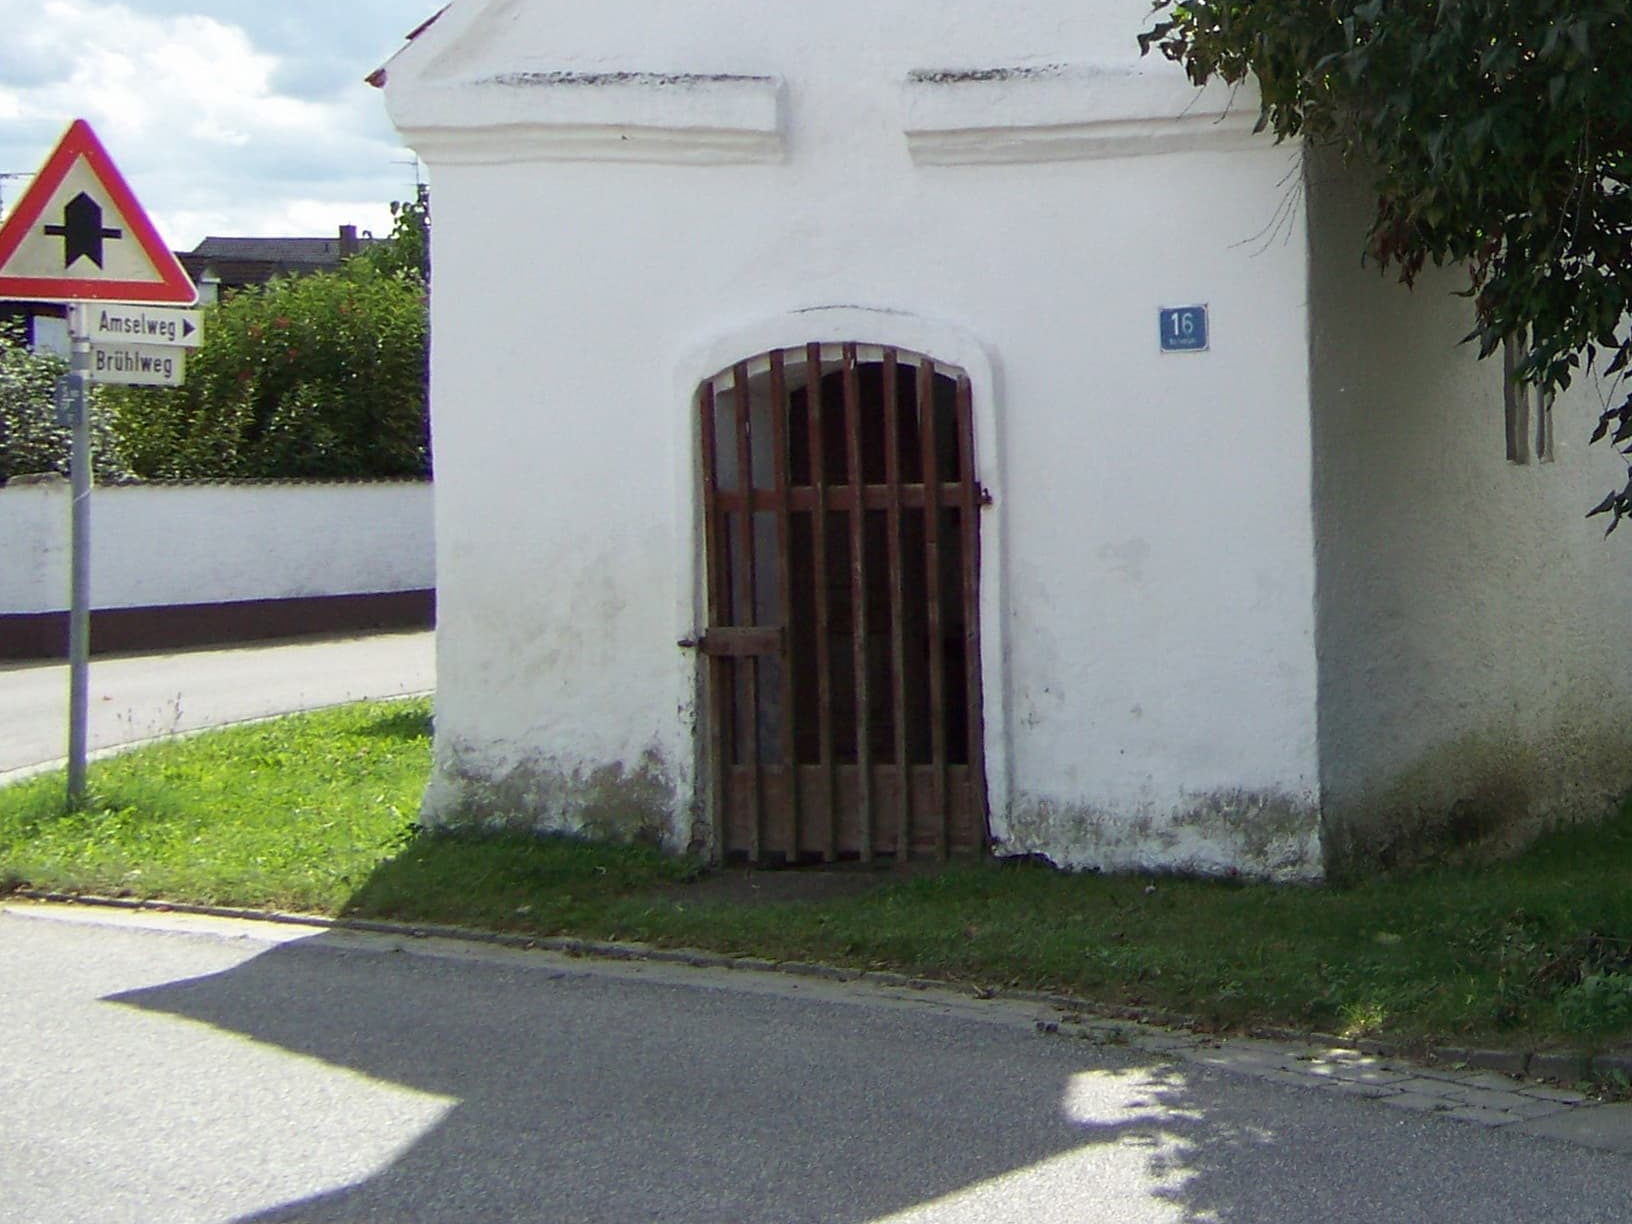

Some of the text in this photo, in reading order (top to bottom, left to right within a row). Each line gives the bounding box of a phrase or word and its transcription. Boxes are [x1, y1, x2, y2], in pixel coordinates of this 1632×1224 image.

[99, 309, 176, 342] Amselweg
[1171, 311, 1194, 337] 16
[96, 350, 172, 378] Brühlweg
